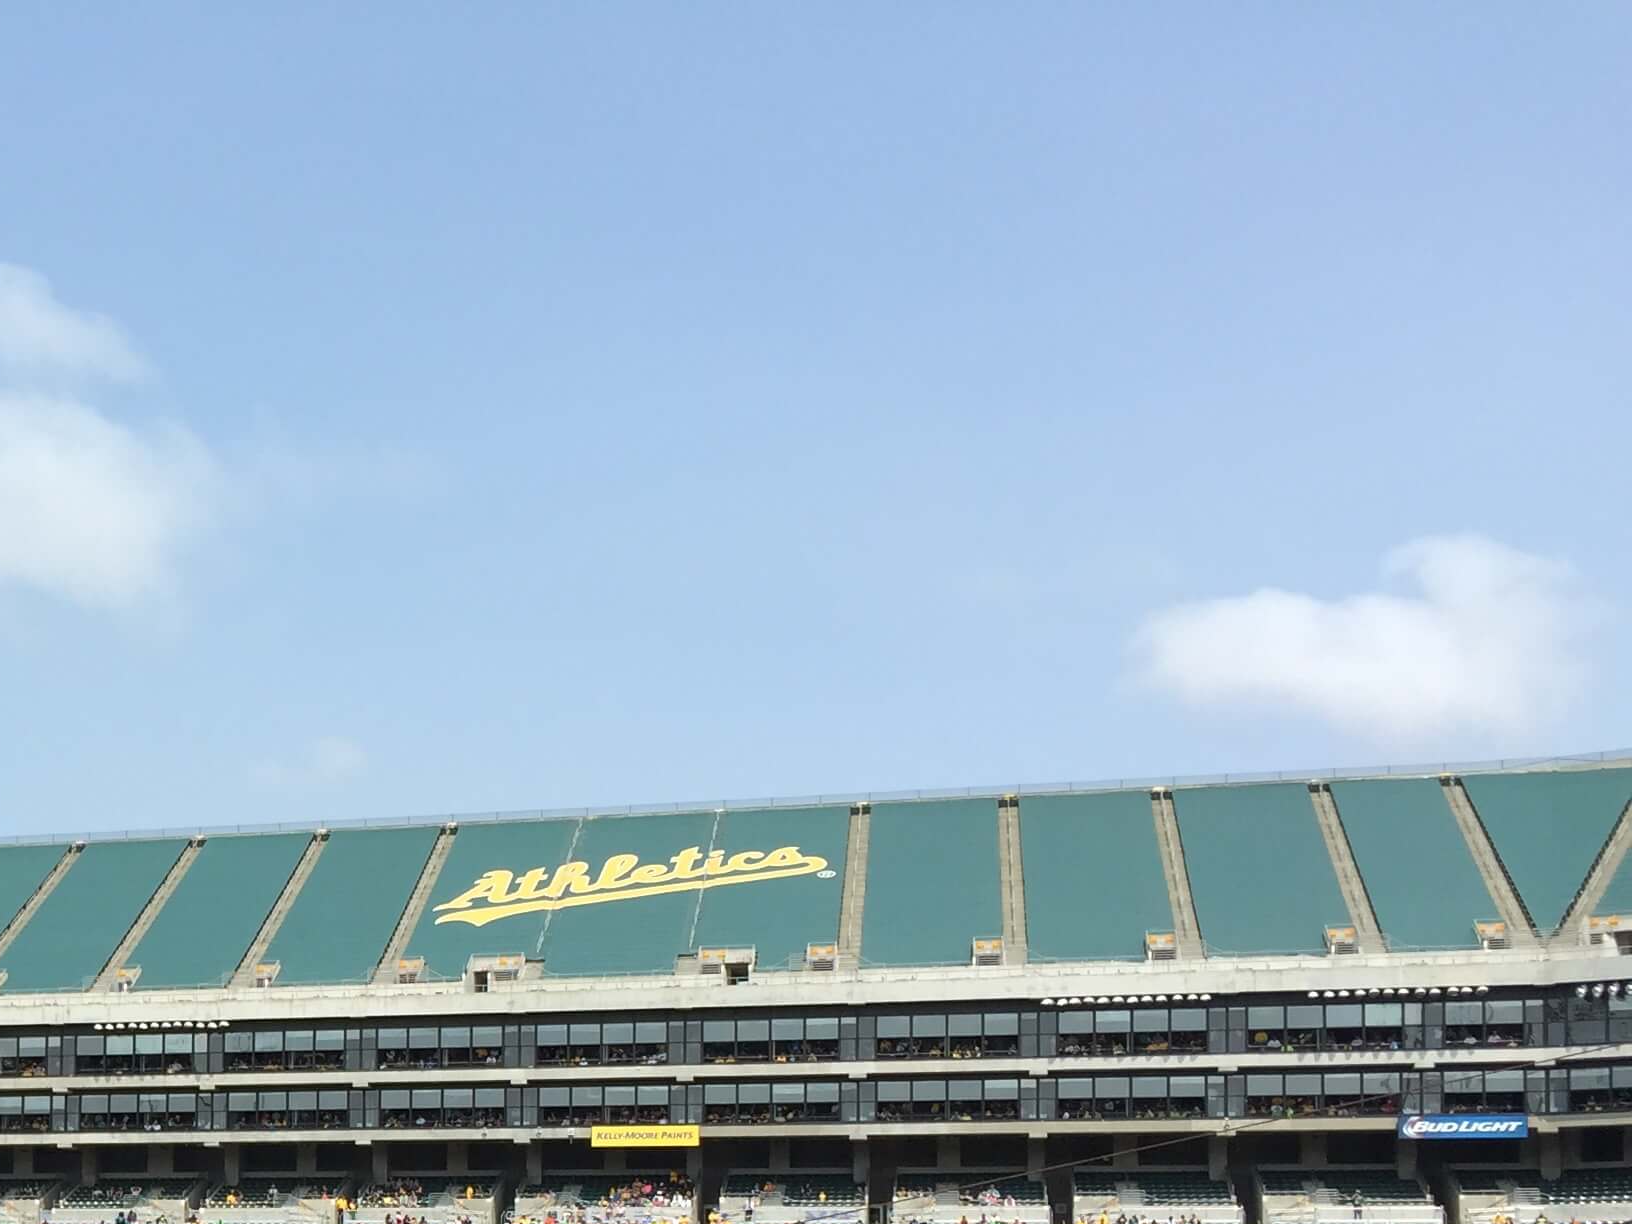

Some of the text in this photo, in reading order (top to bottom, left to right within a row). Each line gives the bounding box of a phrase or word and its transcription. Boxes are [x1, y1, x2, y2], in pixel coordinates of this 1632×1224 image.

[432, 846, 827, 918] Athletics
[1413, 1120, 1523, 1133] BUD LIGHT
